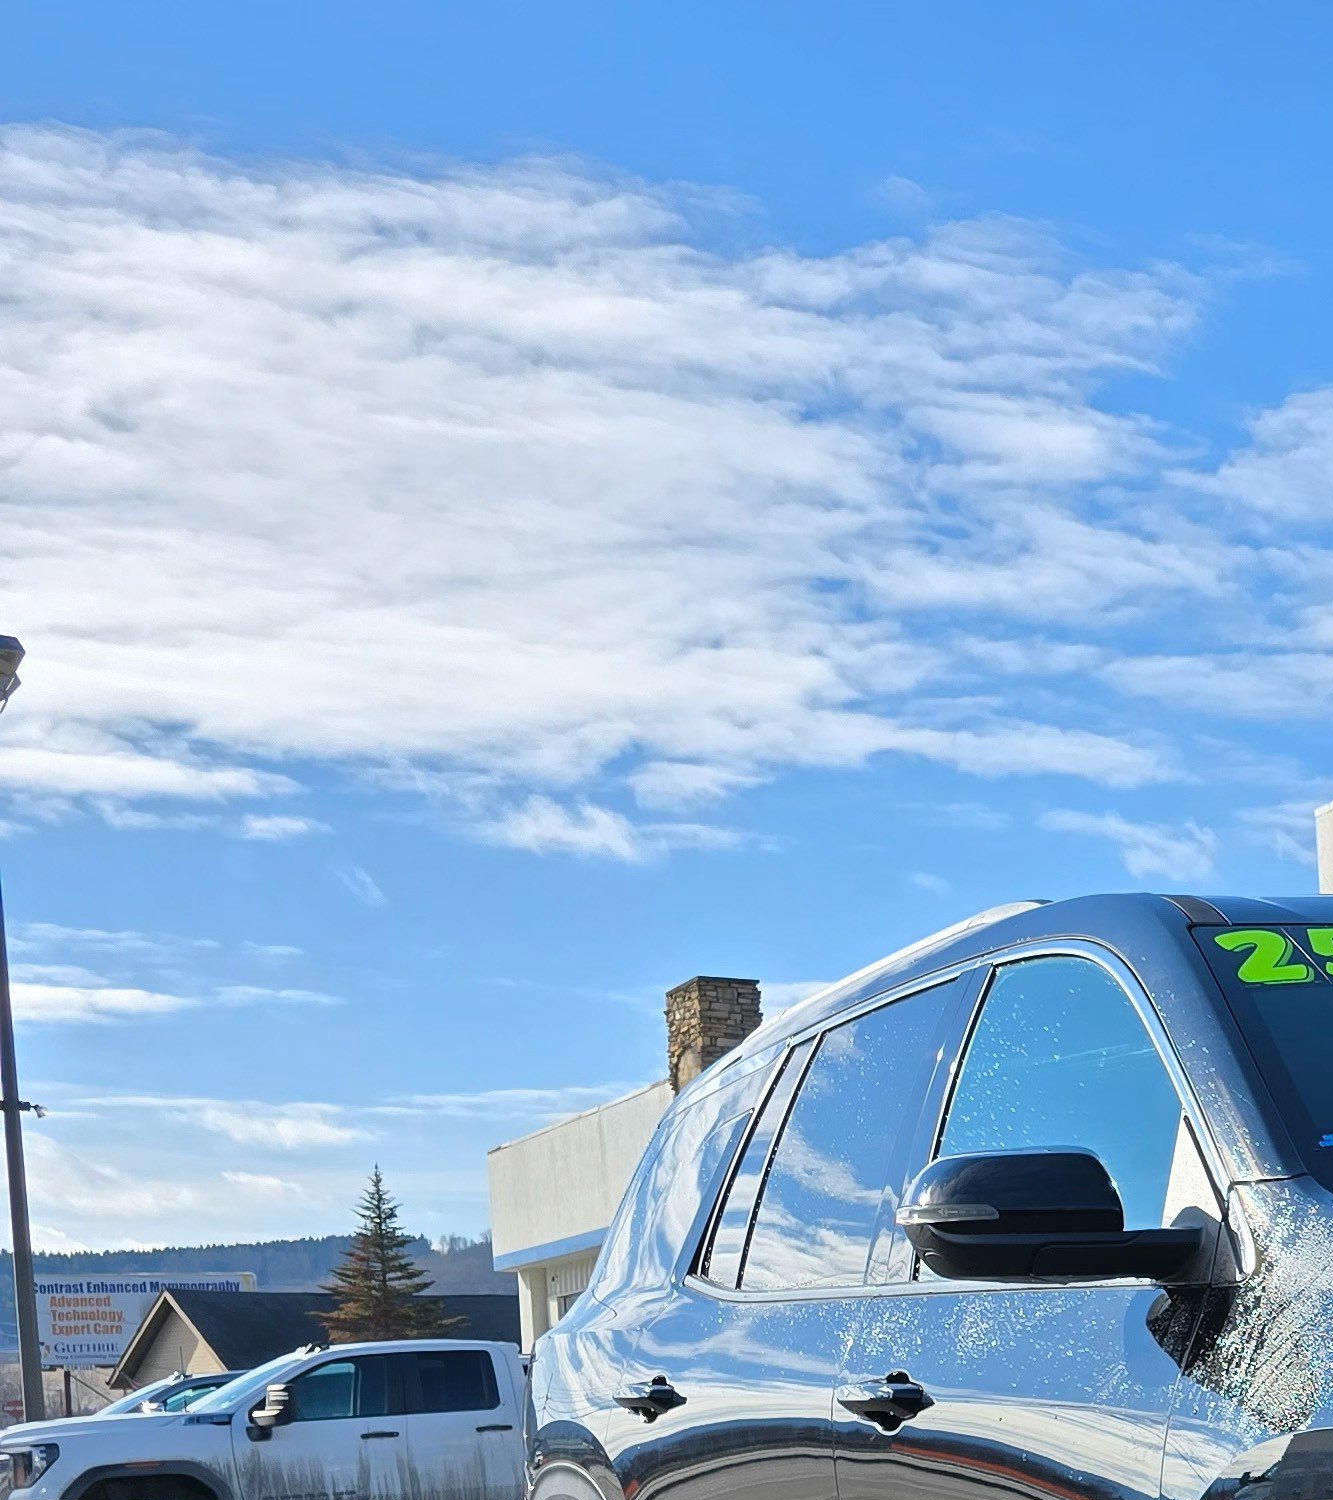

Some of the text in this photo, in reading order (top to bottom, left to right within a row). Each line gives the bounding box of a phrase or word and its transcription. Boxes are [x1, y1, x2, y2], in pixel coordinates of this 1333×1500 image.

[87, 1281, 147, 1293] Enhanced
[50, 1295, 111, 1307] Advanced
[52, 1323, 122, 1336] Expert Care
